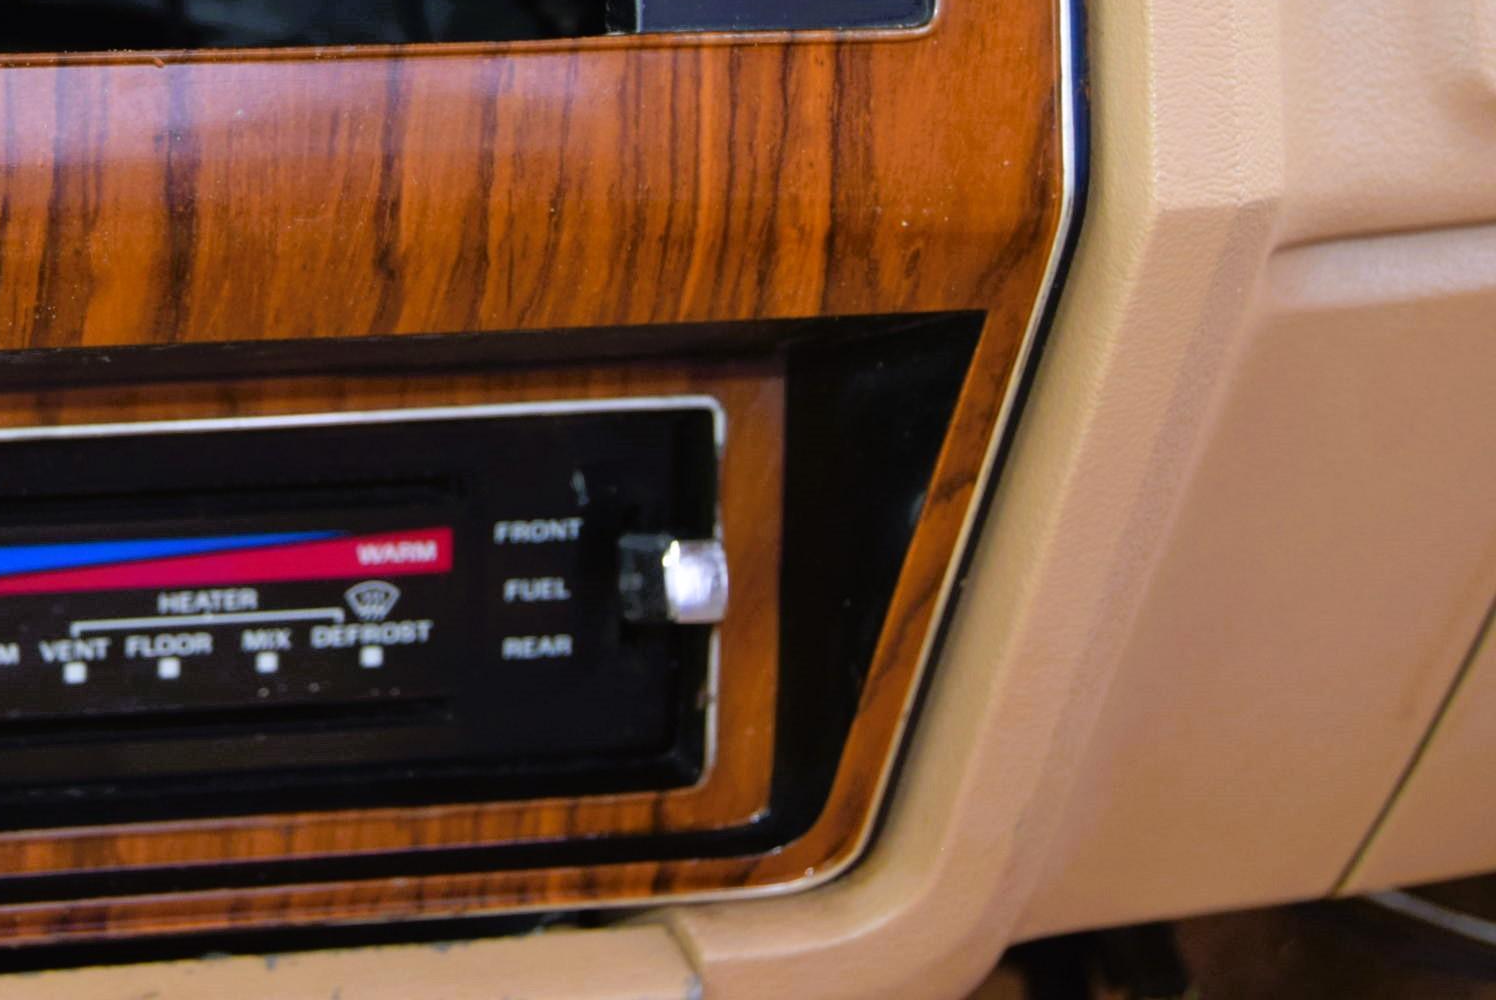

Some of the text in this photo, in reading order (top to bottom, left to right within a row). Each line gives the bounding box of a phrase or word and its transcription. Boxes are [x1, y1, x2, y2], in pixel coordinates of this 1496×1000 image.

[494, 517, 583, 544] FRONT
[356, 540, 438, 566] WARM
[157, 588, 258, 614] HEATER
[504, 577, 571, 602] FUEL
[38, 636, 111, 664] VENT
[124, 632, 213, 659] FLOOR
[241, 628, 291, 652] MIX
[310, 620, 434, 649] DEFROST
[502, 634, 572, 660] REAR
